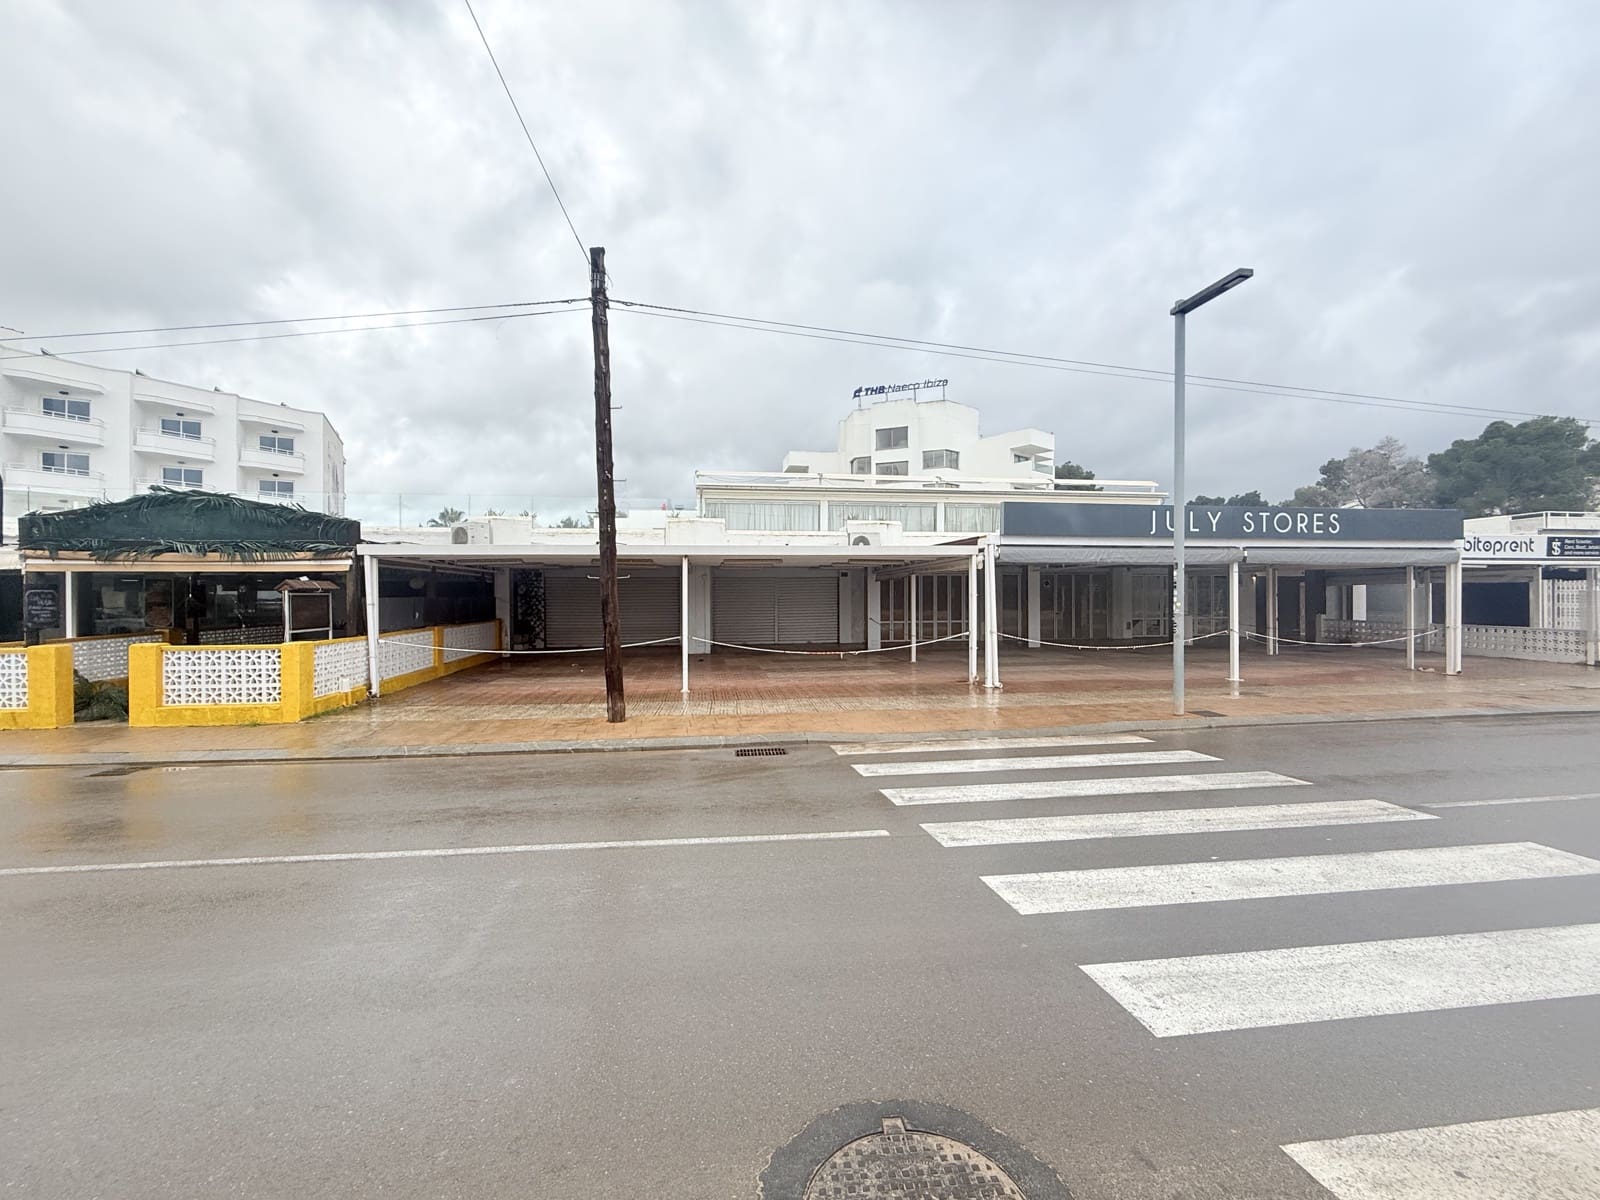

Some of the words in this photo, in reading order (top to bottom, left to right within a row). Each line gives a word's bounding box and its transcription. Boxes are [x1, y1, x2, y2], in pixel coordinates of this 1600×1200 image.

[864, 385, 885, 396] THB
[887, 382, 920, 393] Naeco
[924, 378, 948, 389] Ibiza
[1242, 511, 1340, 534] STORES
